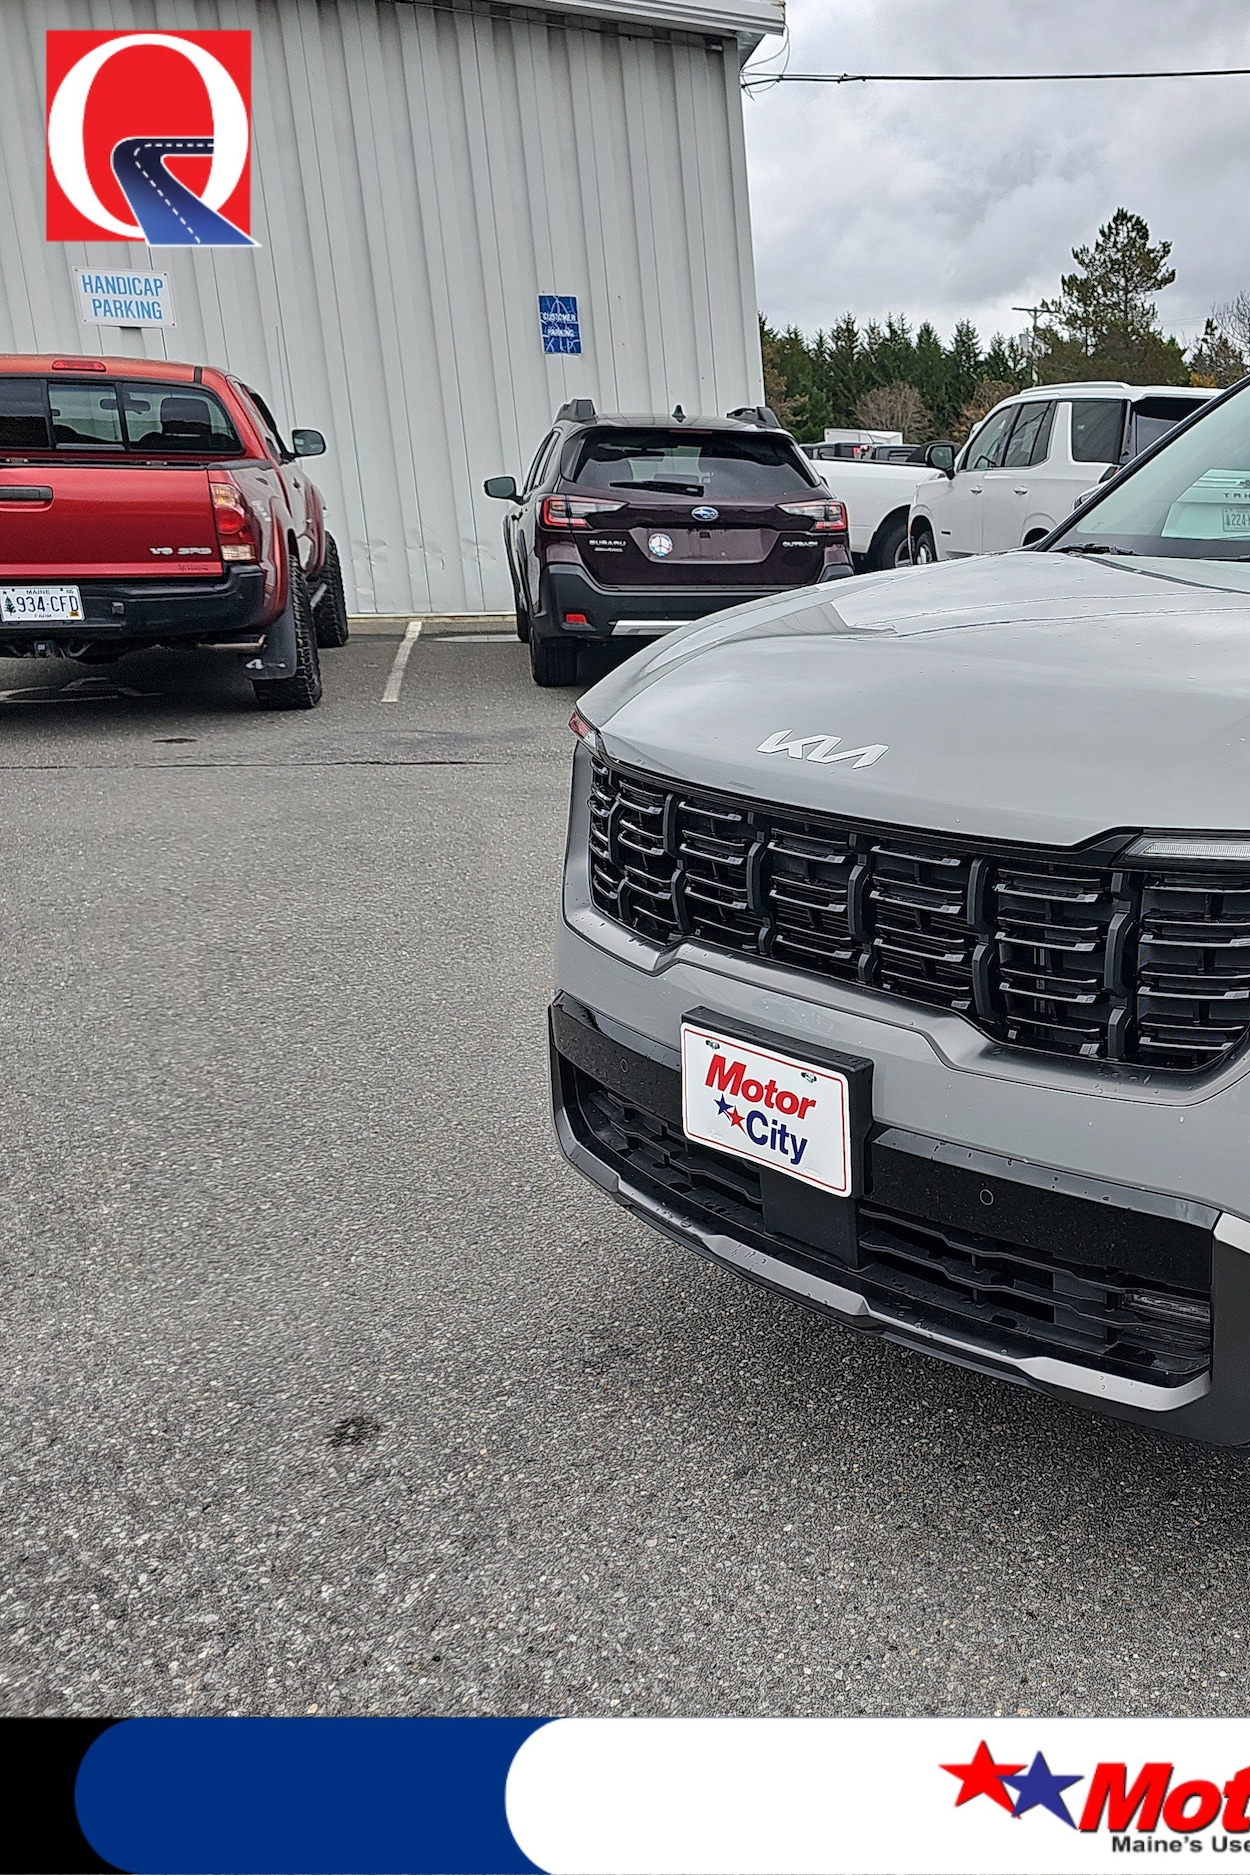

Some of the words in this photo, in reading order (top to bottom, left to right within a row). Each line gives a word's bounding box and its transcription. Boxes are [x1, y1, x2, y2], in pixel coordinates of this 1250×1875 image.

[81, 274, 164, 297] HANDICAP
[91, 298, 163, 320] PARKING
[756, 729, 889, 769] KIA
[704, 1053, 817, 1120] Motor
[746, 1110, 808, 1165] City
